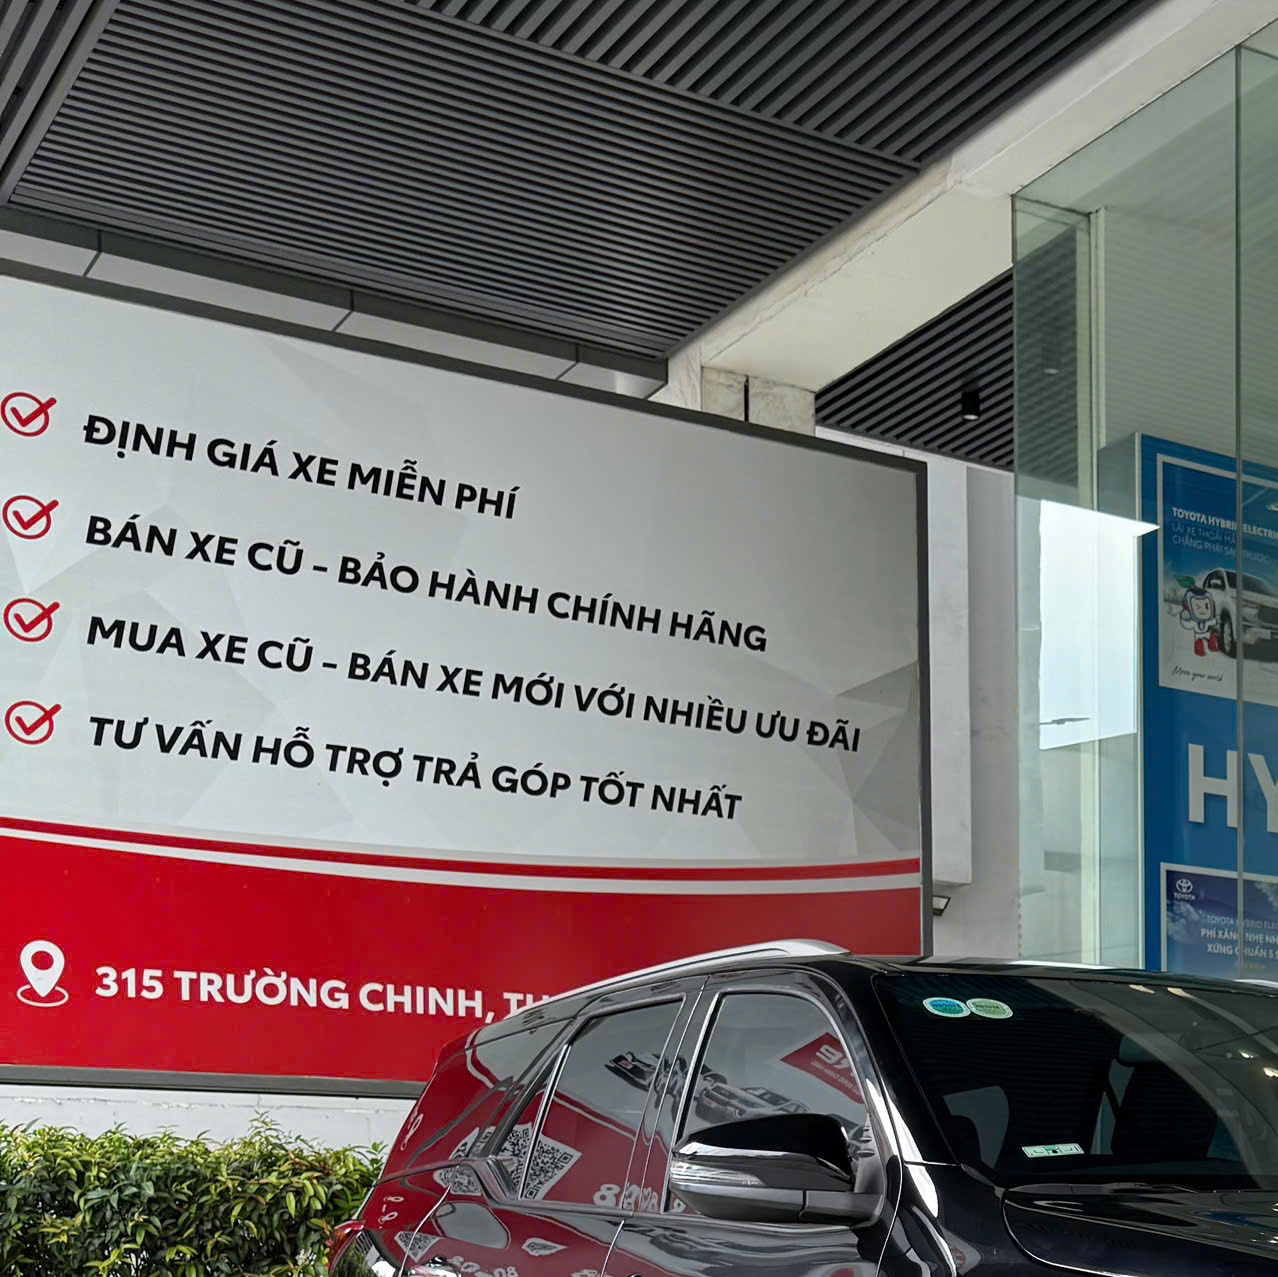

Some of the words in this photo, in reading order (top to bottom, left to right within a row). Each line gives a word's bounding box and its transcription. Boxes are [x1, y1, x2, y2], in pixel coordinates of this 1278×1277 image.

[83, 414, 197, 459] ĐỊNH
[207, 439, 280, 476] GIÁ
[288, 451, 338, 486] XE
[347, 459, 446, 506] MIỄN
[454, 484, 521, 519] PHÍ
[1172, 507, 1207, 523] TOYOTA
[1208, 517, 1242, 531] HYBRI
[85, 514, 177, 556] BÁN
[185, 531, 238, 566] XE
[247, 540, 303, 575] CŨ
[338, 552, 419, 594] BẢO
[428, 568, 539, 614] HÀNH
[547, 592, 662, 634] CHÍNH
[669, 610, 767, 652] HÃNG
[87, 616, 186, 657] MUA
[195, 631, 248, 665] XE
[257, 638, 314, 672] CŨ
[348, 650, 429, 690] BÁN
[436, 665, 483, 697] XE
[491, 672, 564, 709] MỚI
[574, 683, 635, 719] VỚI
[643, 694, 747, 735] NHIỀU
[756, 710, 800, 742] ƯU
[806, 718, 861, 753] ĐÃI
[89, 716, 149, 751] TƯ
[155, 720, 243, 761] VẤN
[252, 727, 315, 769] HỖ
[325, 743, 404, 787] TRỢ
[412, 752, 482, 790] TRẢ
[491, 762, 572, 799] GÓP
[579, 771, 645, 808] TỐT
[651, 784, 743, 820] NHẤT
[95, 966, 164, 1000] 315
[174, 967, 350, 1010] TRƯỜNG
[358, 982, 495, 1024] CHINH,
